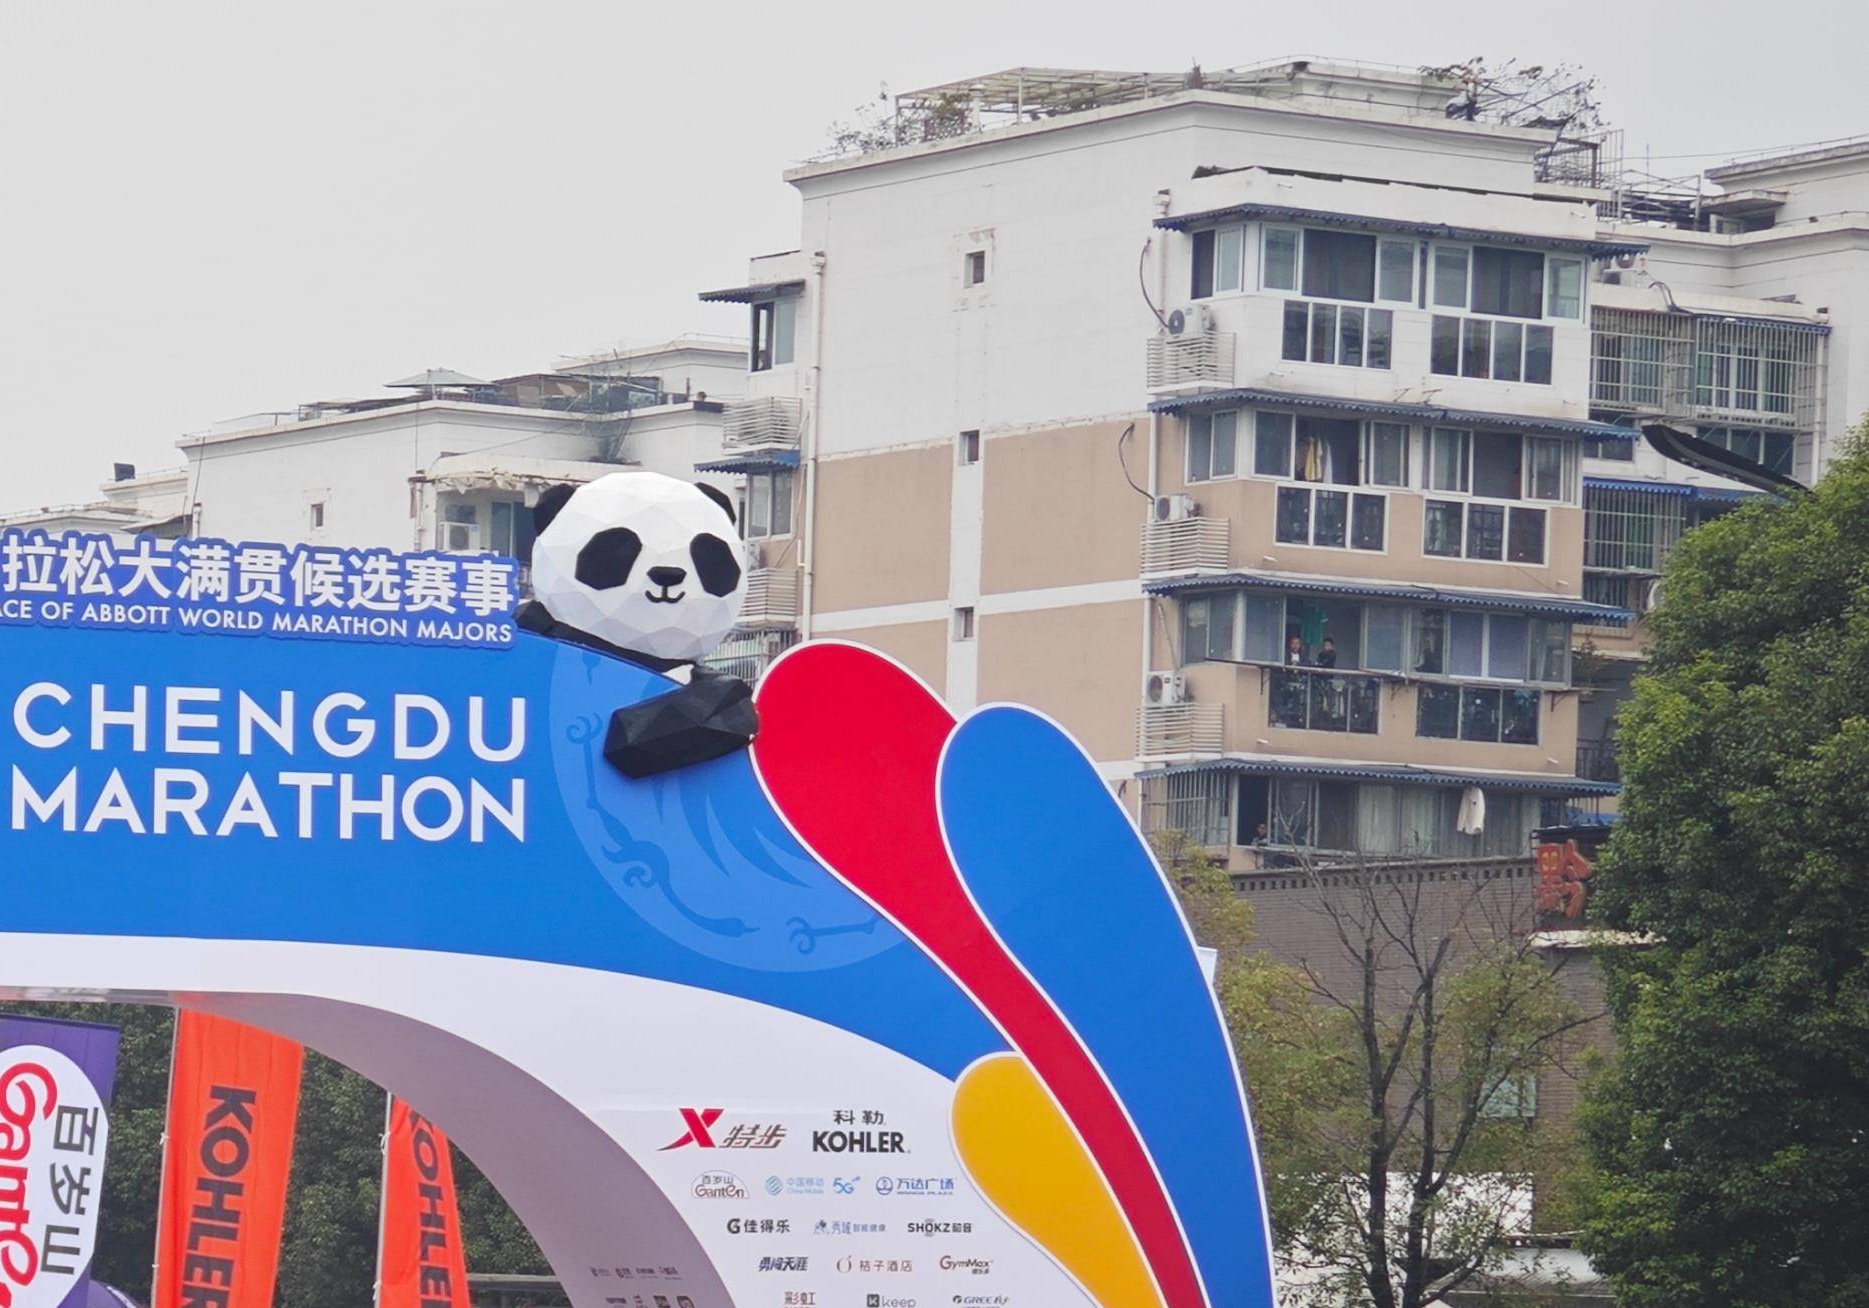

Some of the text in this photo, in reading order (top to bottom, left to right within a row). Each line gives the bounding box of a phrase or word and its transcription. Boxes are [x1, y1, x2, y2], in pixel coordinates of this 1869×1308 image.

[40, 601, 75, 622] OF
[81, 603, 171, 626] ABBOTT
[179, 606, 265, 631] WORLD
[272, 612, 408, 639] MARATHON
[417, 618, 513, 644] MAJORS
[12, 682, 528, 763] CHENGDU
[11, 763, 526, 844] MARATHON
[832, 1109, 885, 1127] 科勒
[718, 1123, 787, 1150] 特步
[811, 1130, 906, 1154] KOHLER
[701, 1175, 734, 1186] 百岁山
[786, 1177, 825, 1188] 中国移动
[832, 1176, 856, 1196] 5G
[896, 1177, 955, 1191] 万达广场
[40, 1104, 101, 1277] 百岁山
[743, 1218, 791, 1234] 佳得乐
[907, 1220, 950, 1236] SHOKZ
[758, 1256, 809, 1272] 勇闯天涯
[859, 1259, 913, 1273] 桔子酒店
